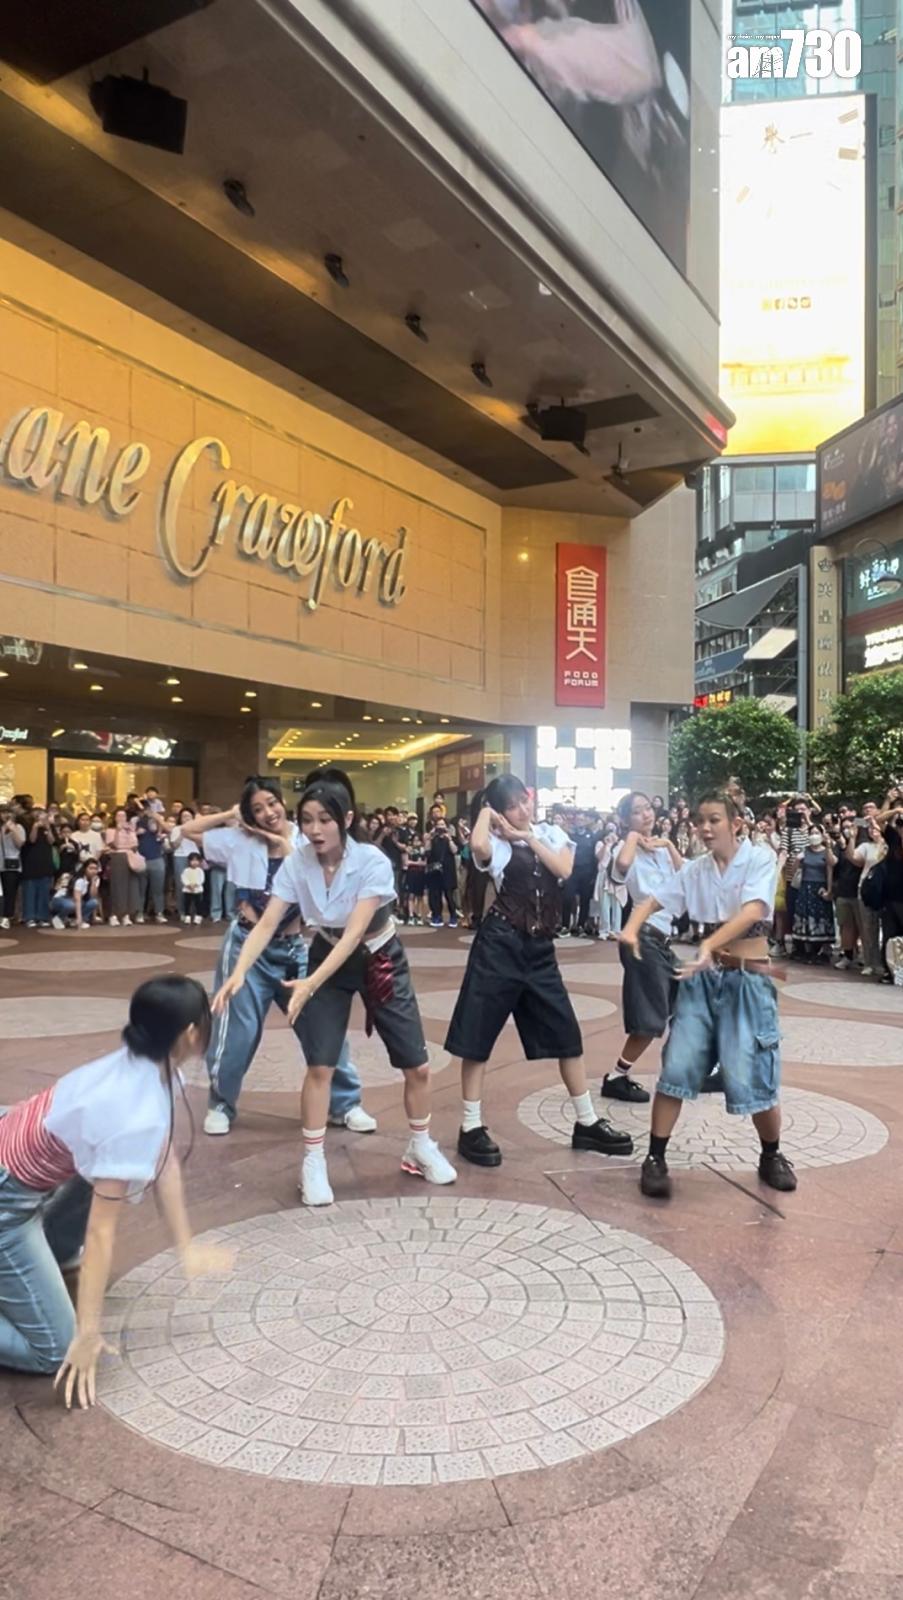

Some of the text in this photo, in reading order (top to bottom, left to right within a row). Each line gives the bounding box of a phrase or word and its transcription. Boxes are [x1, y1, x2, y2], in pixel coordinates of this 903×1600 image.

[0, 406, 410, 611] ane Crawford
[564, 565, 599, 662] 食通天
[563, 670, 599, 679] FOOD
[563, 678, 599, 687] FORUM
